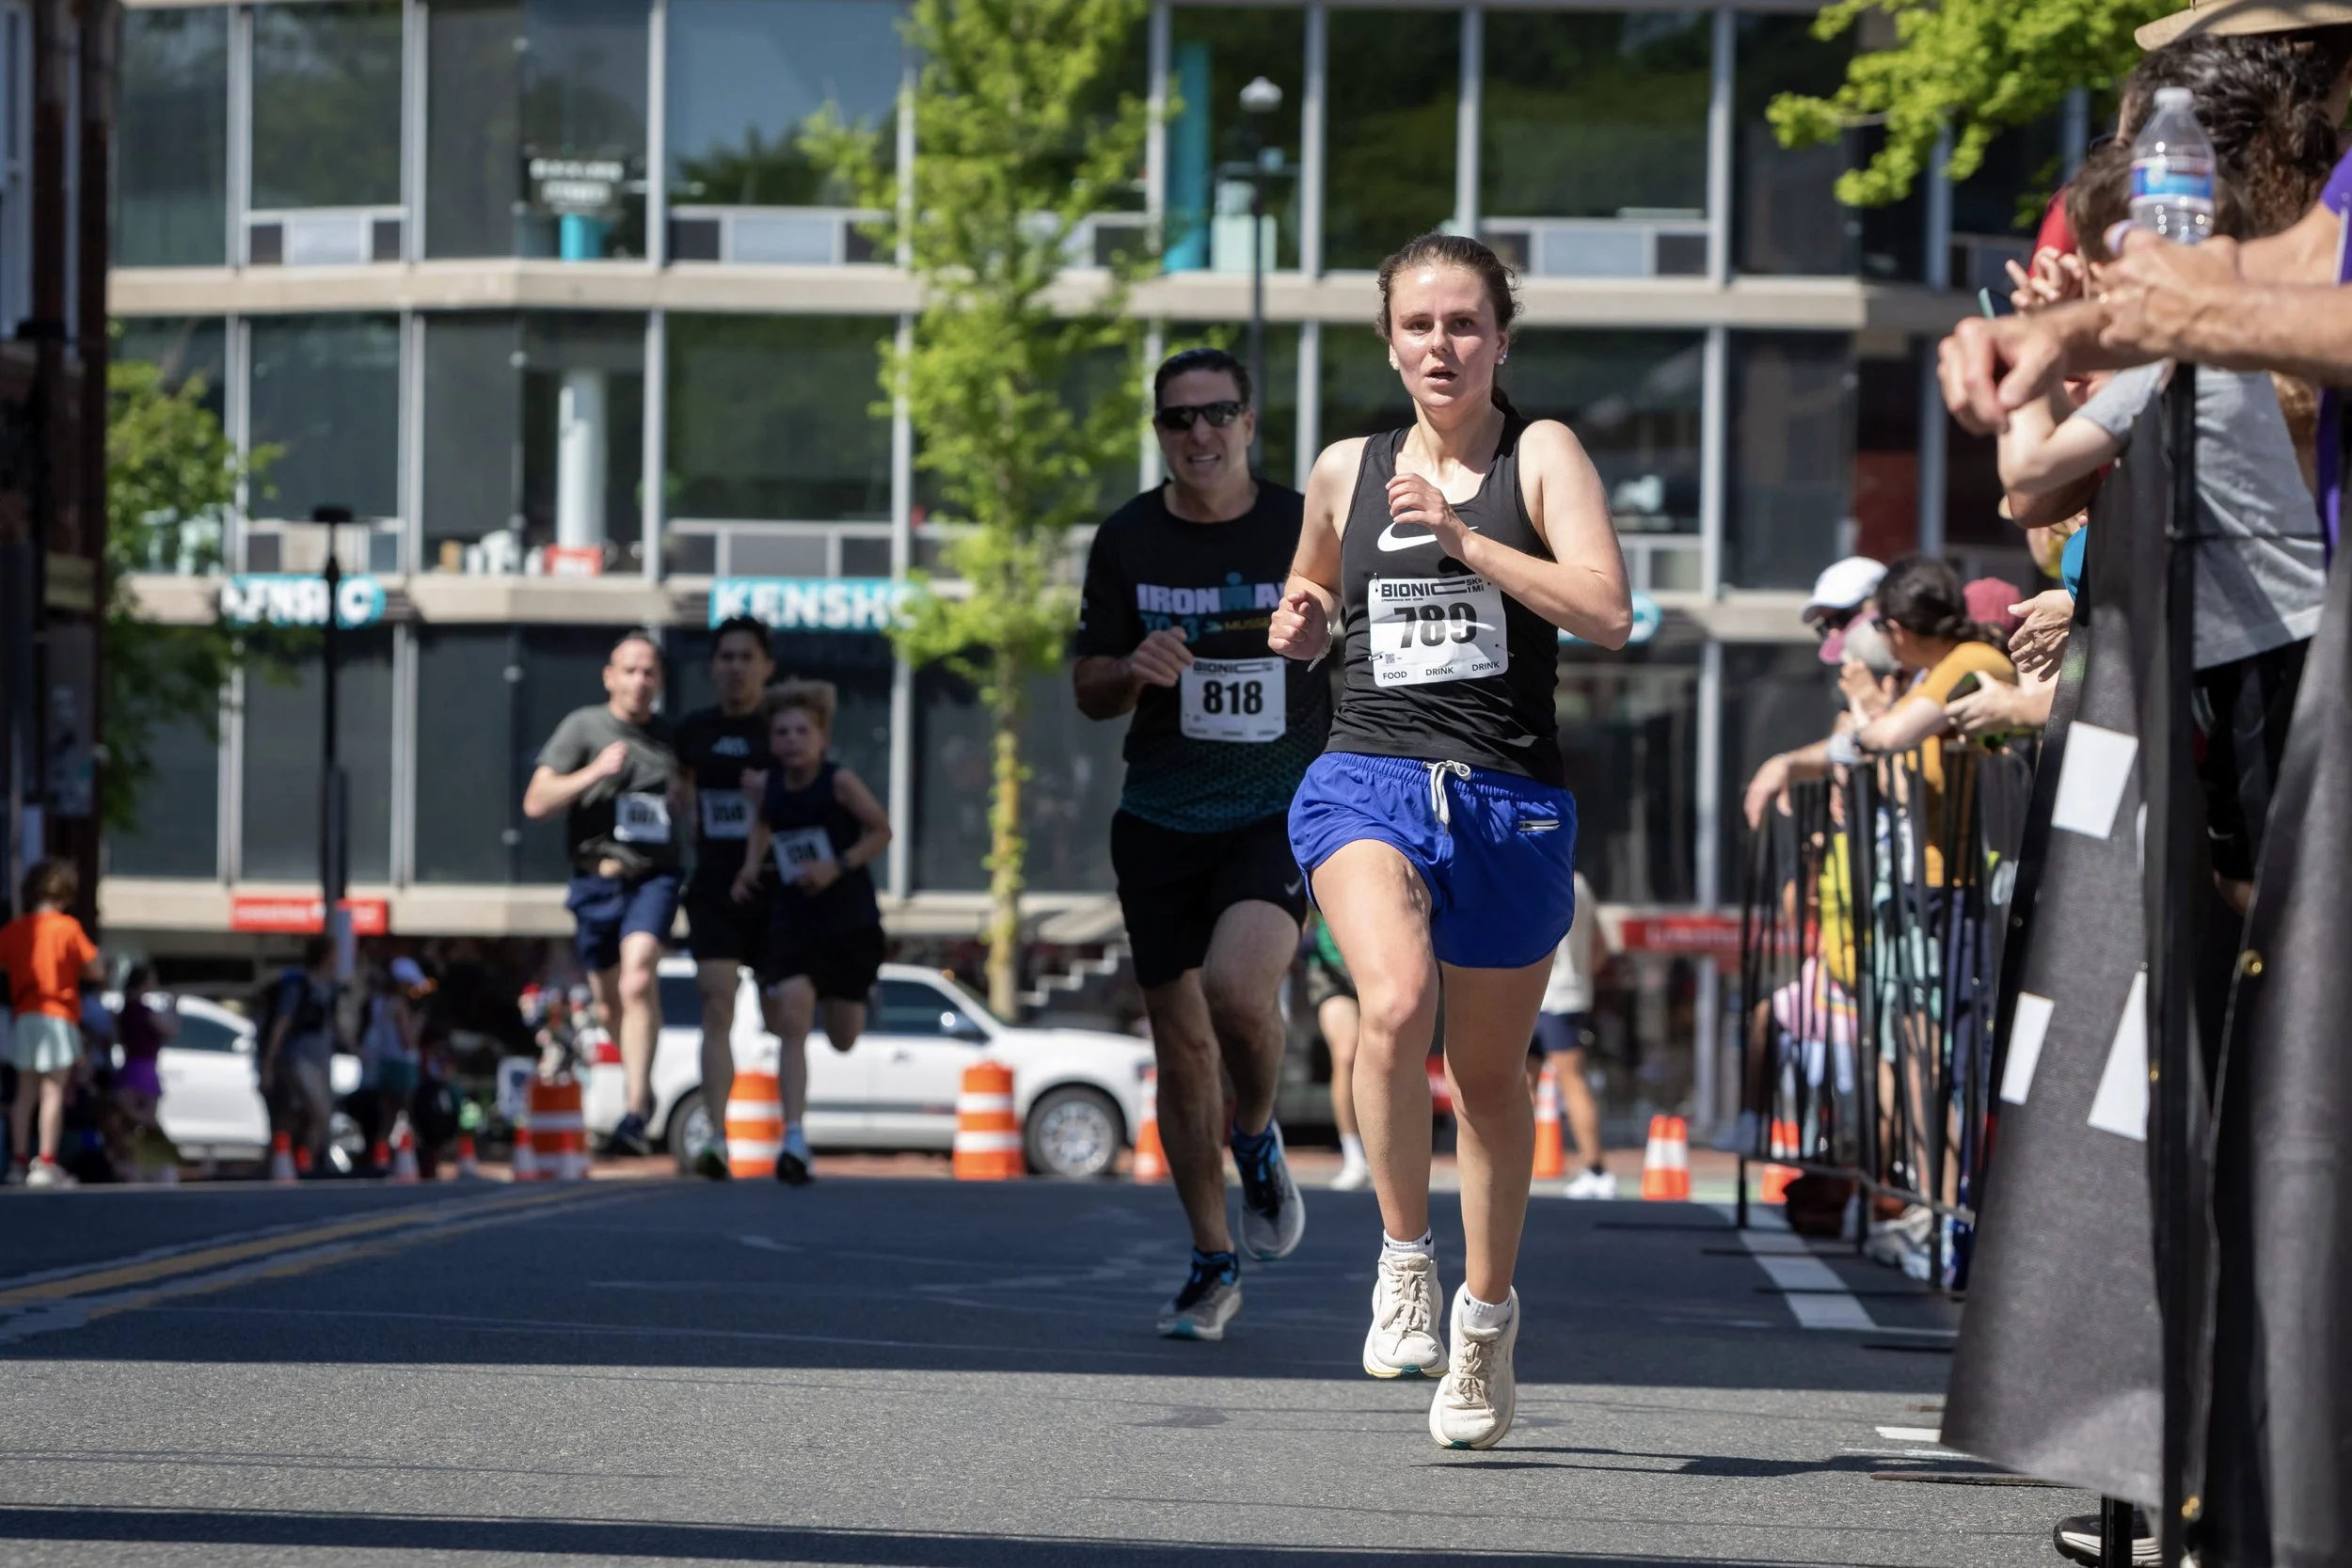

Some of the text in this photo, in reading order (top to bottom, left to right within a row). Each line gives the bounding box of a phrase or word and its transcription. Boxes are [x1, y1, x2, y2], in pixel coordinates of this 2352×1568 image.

[1136, 580, 1285, 616] IRONMA
[1381, 580, 1468, 597] BIONIC
[1393, 602, 1477, 649] 789
[1193, 660, 1262, 673] BIONIC
[1383, 661, 1501, 679] FOOD DRINK DRINK
[1203, 679, 1263, 715] 818
